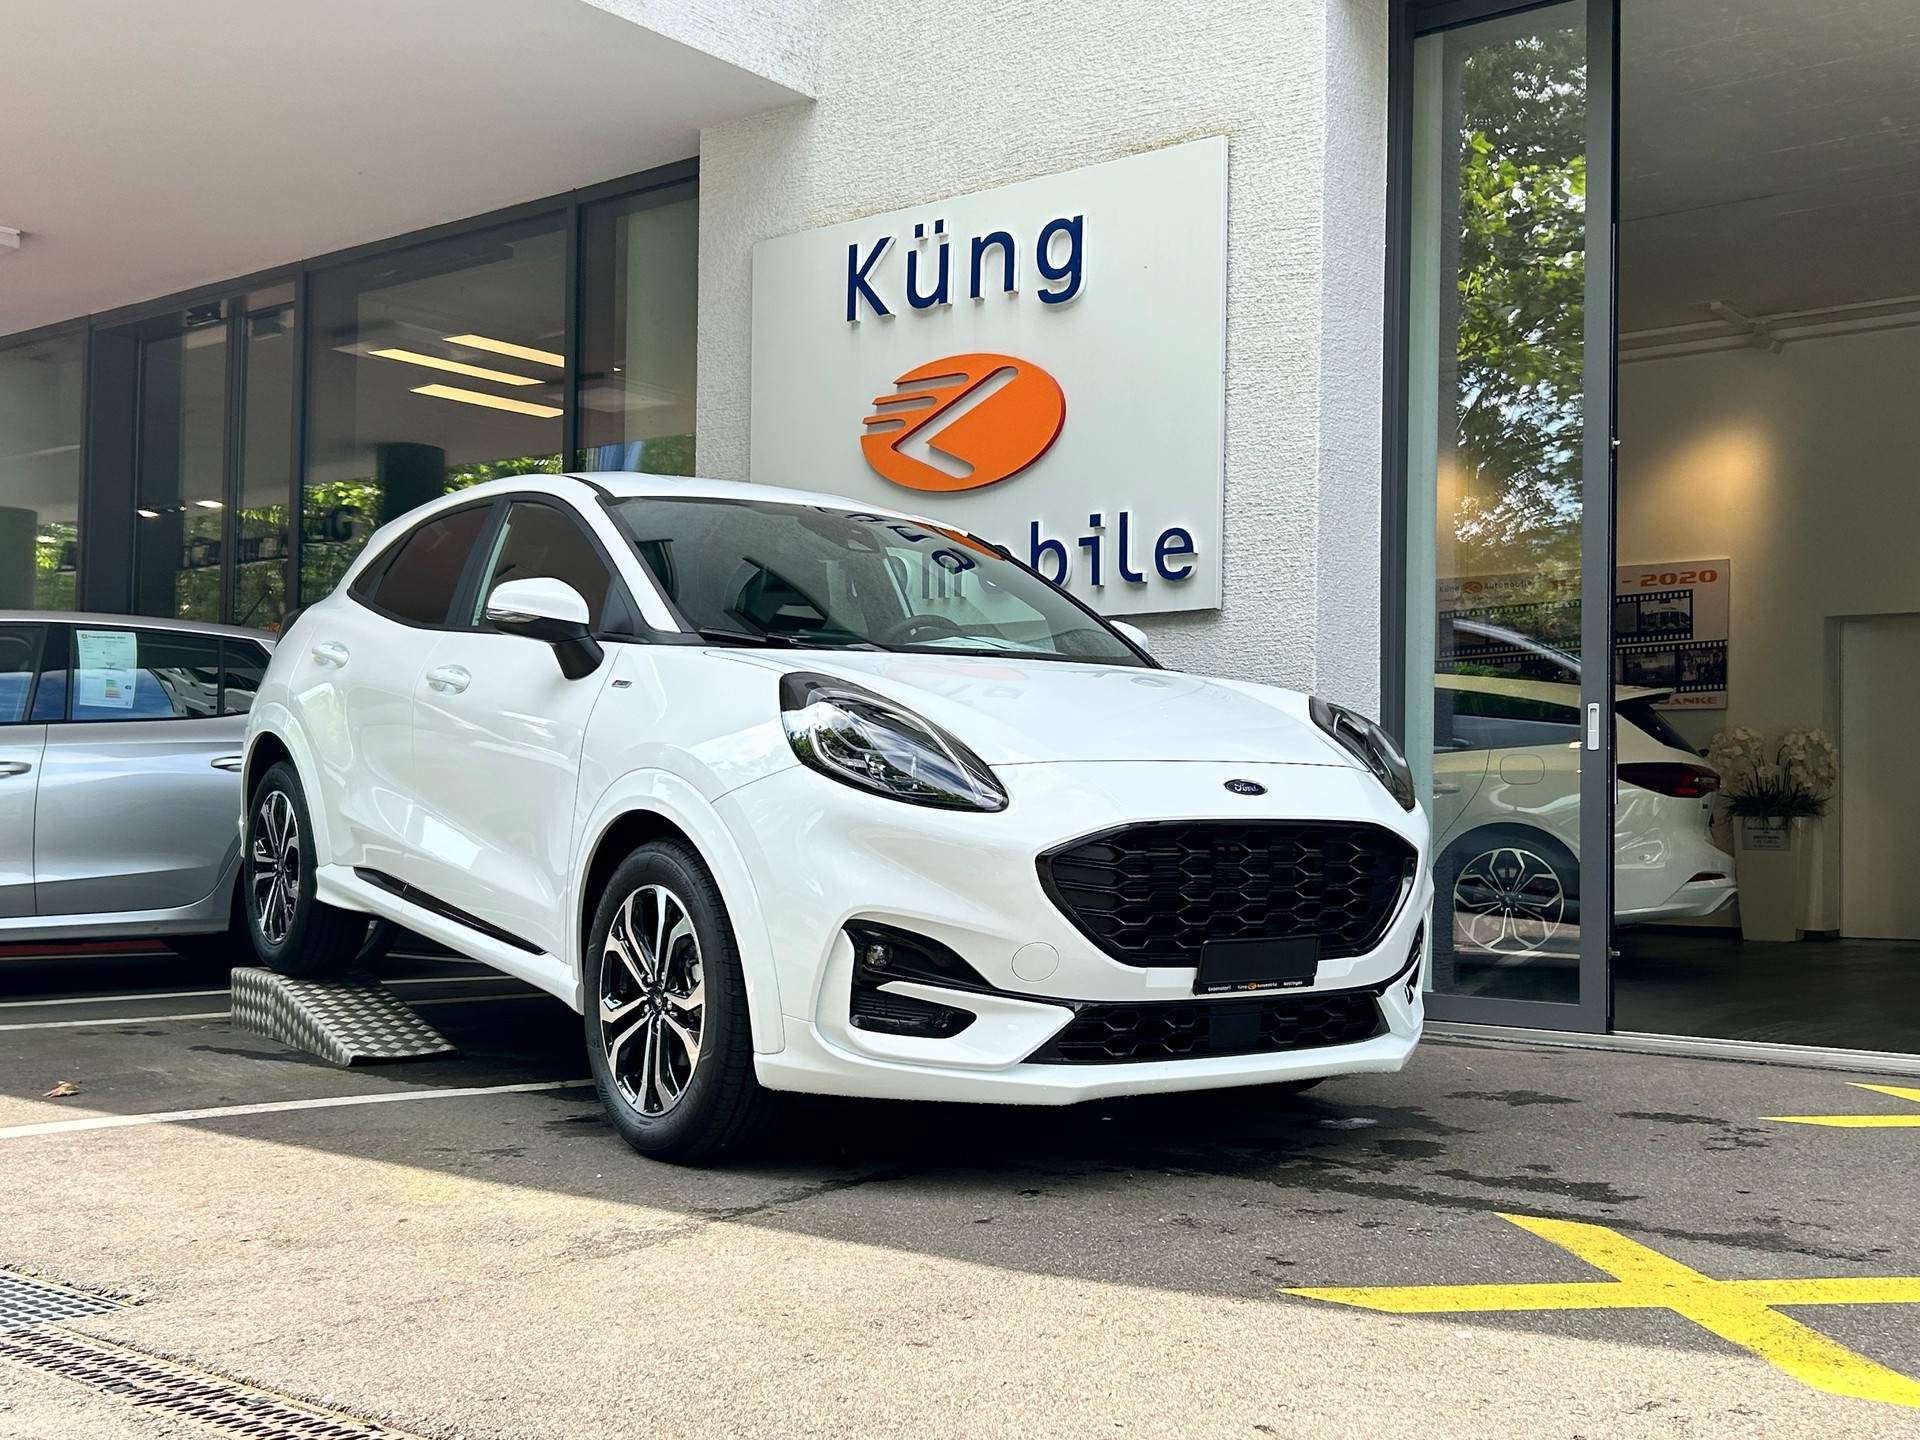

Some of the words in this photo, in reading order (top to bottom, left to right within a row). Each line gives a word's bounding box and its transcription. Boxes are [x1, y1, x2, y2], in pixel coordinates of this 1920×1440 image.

[846, 214, 1088, 321] Küng
[1640, 569, 1718, 587] 2020
[1659, 696, 1718, 706] ANKE
[1233, 782, 1259, 792] Ford
